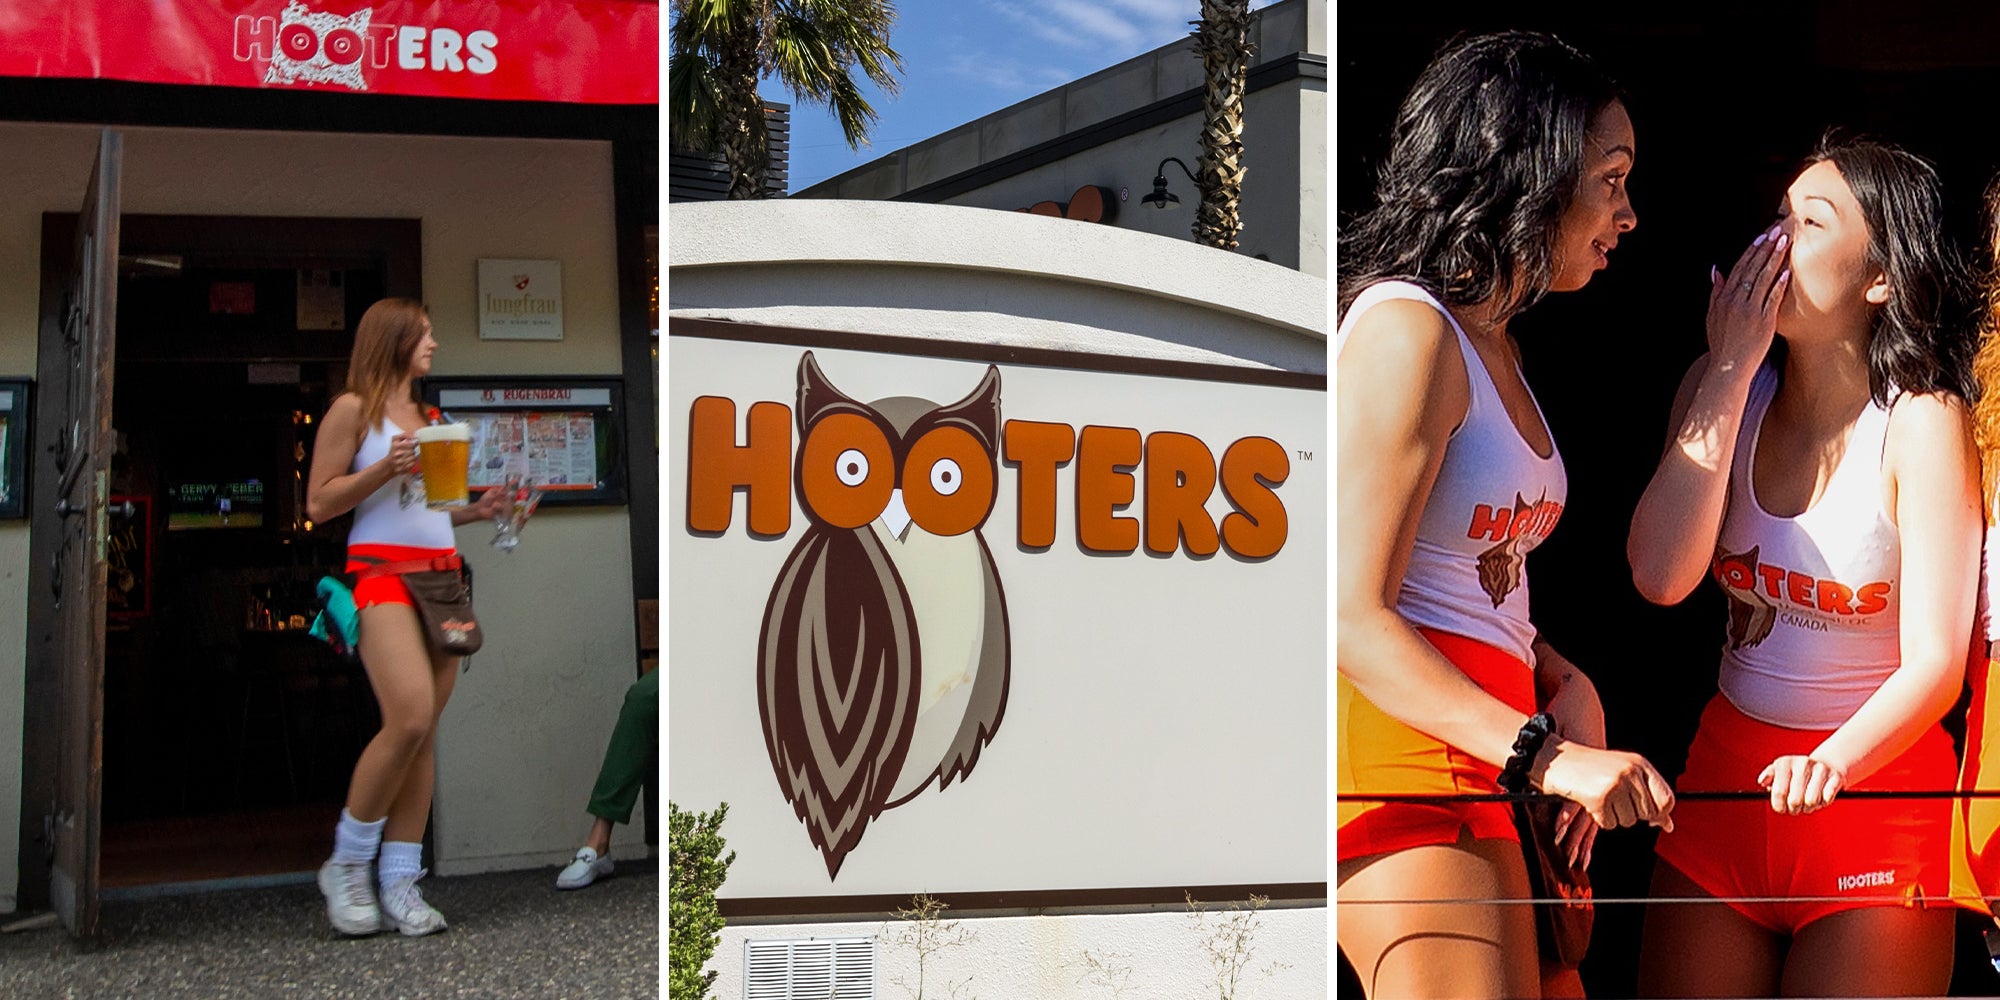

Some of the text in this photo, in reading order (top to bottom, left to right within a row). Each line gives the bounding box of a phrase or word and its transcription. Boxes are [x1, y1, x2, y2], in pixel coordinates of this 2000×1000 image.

[233, 14, 498, 74] HOOTERS
[485, 292, 556, 317] Jungfrau
[685, 395, 1291, 557] HOOTERS
[1297, 450, 1313, 461] TM
[1780, 612, 1829, 632] CANADA
[1838, 870, 1895, 892] HOOTERS
